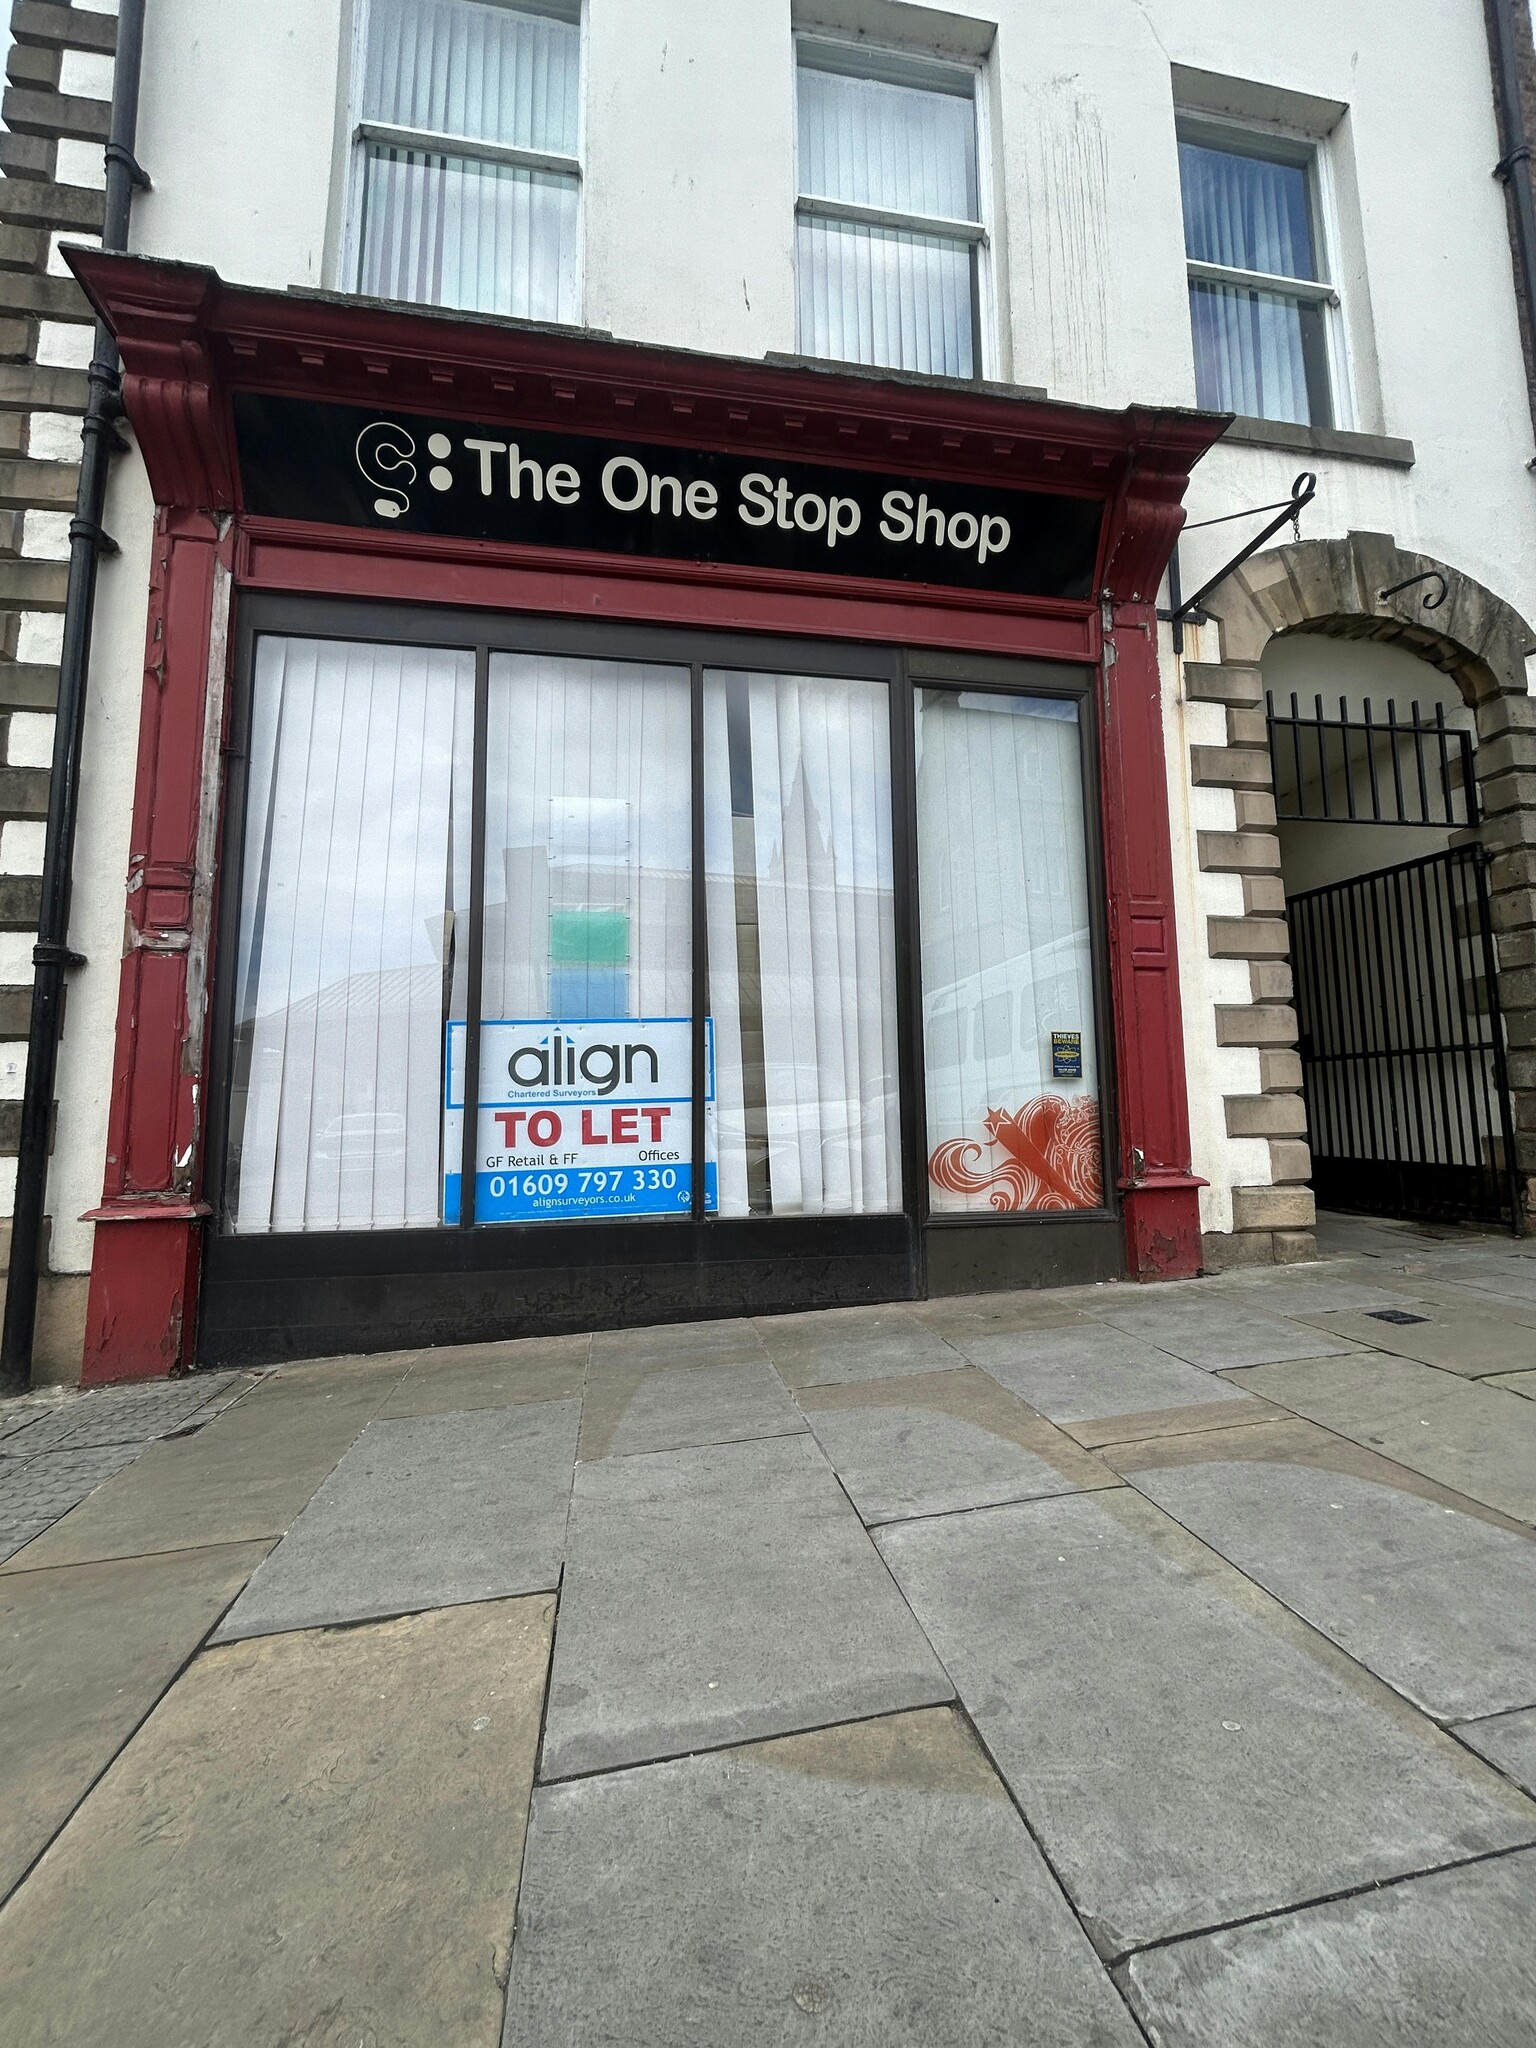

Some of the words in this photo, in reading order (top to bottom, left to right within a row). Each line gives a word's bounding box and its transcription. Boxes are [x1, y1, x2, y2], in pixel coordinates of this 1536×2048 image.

[464, 438, 581, 505] The
[601, 456, 719, 520] One
[737, 472, 861, 548] Stop
[879, 490, 1011, 564] Shop
[508, 1035, 658, 1096] align
[507, 1090, 551, 1098] Chartered
[552, 1089, 597, 1098] Surveyors
[495, 1110, 562, 1148] TO
[581, 1107, 671, 1145] LET
[486, 1156, 504, 1168] GF
[508, 1154, 545, 1167] Retail
[549, 1154, 559, 1165] &
[563, 1153, 579, 1164] FF
[638, 1149, 680, 1161] Offices
[489, 1173, 569, 1198] 01609
[578, 1170, 624, 1193] 797
[632, 1168, 677, 1190] 330
[532, 1192, 636, 1208] alignsurveyors.co.uk
